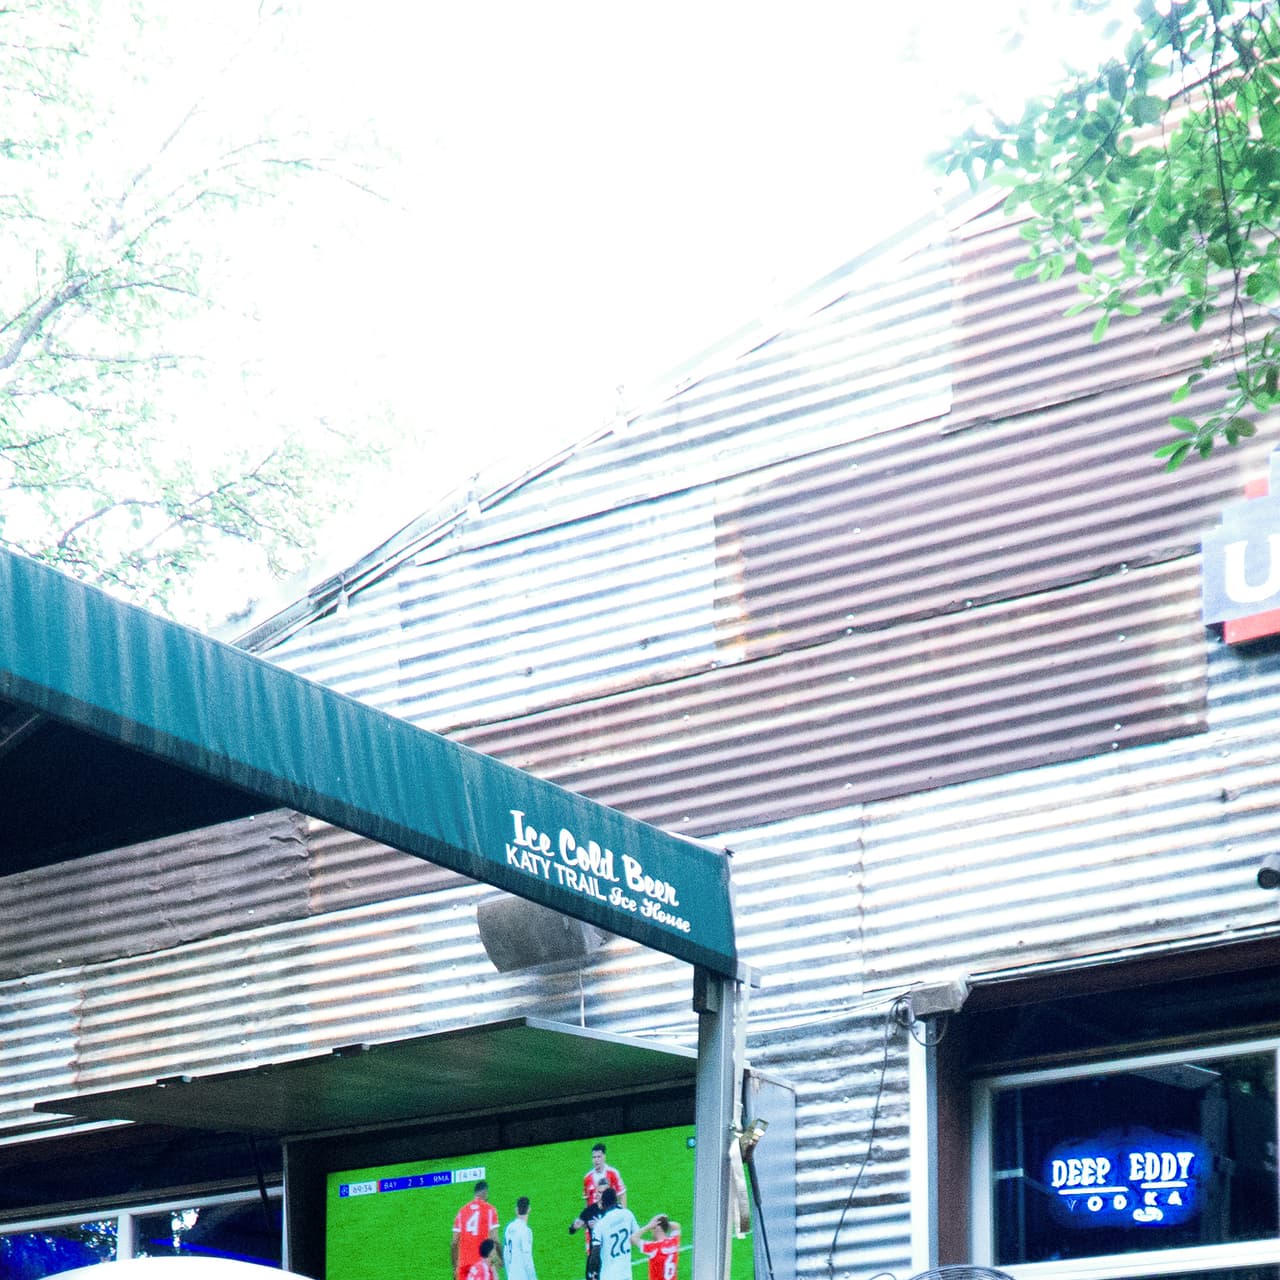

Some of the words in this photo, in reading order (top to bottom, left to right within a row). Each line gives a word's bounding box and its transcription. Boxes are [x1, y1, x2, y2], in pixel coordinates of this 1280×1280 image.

[509, 809, 555, 858] Ice
[559, 829, 620, 883] Cold
[621, 853, 679, 907] Beer
[505, 843, 551, 880] KATY
[554, 861, 607, 902] TRAIL
[609, 886, 638, 913] Ice
[640, 898, 691, 934] House
[433, 1175, 450, 1183] RMA
[1051, 1157, 1110, 1188] DEEP
[1129, 1152, 1195, 1181] EDDY
[466, 1209, 480, 1235] 4
[610, 1228, 631, 1258] 22
[664, 1255, 676, 1280] 6
